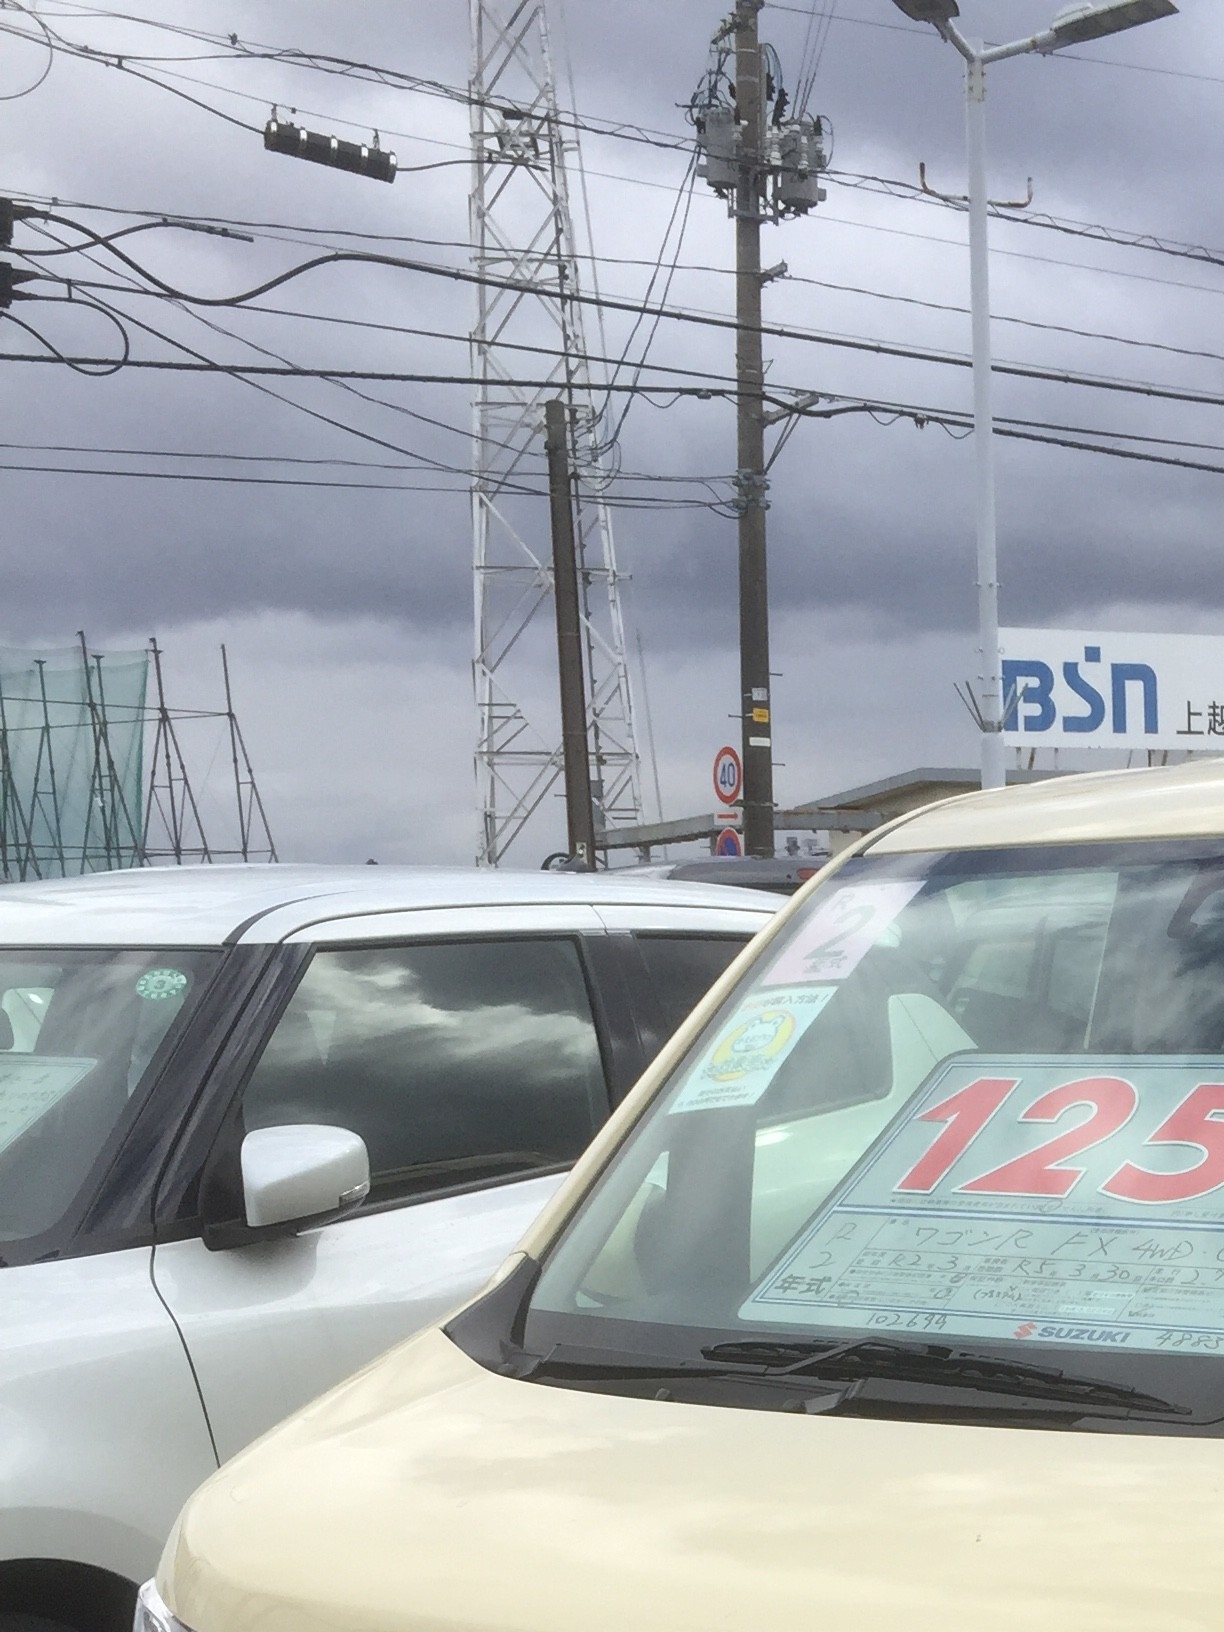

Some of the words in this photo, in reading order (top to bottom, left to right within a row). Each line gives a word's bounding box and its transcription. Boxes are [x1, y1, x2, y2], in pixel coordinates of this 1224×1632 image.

[719, 763, 736, 787] 40
[803, 904, 876, 959] 2
[1050, 1231, 1118, 1257] FX
[808, 1250, 836, 1269] 2
[775, 1273, 833, 1296] 年式
[1038, 1325, 1132, 1344] SUZUKI
